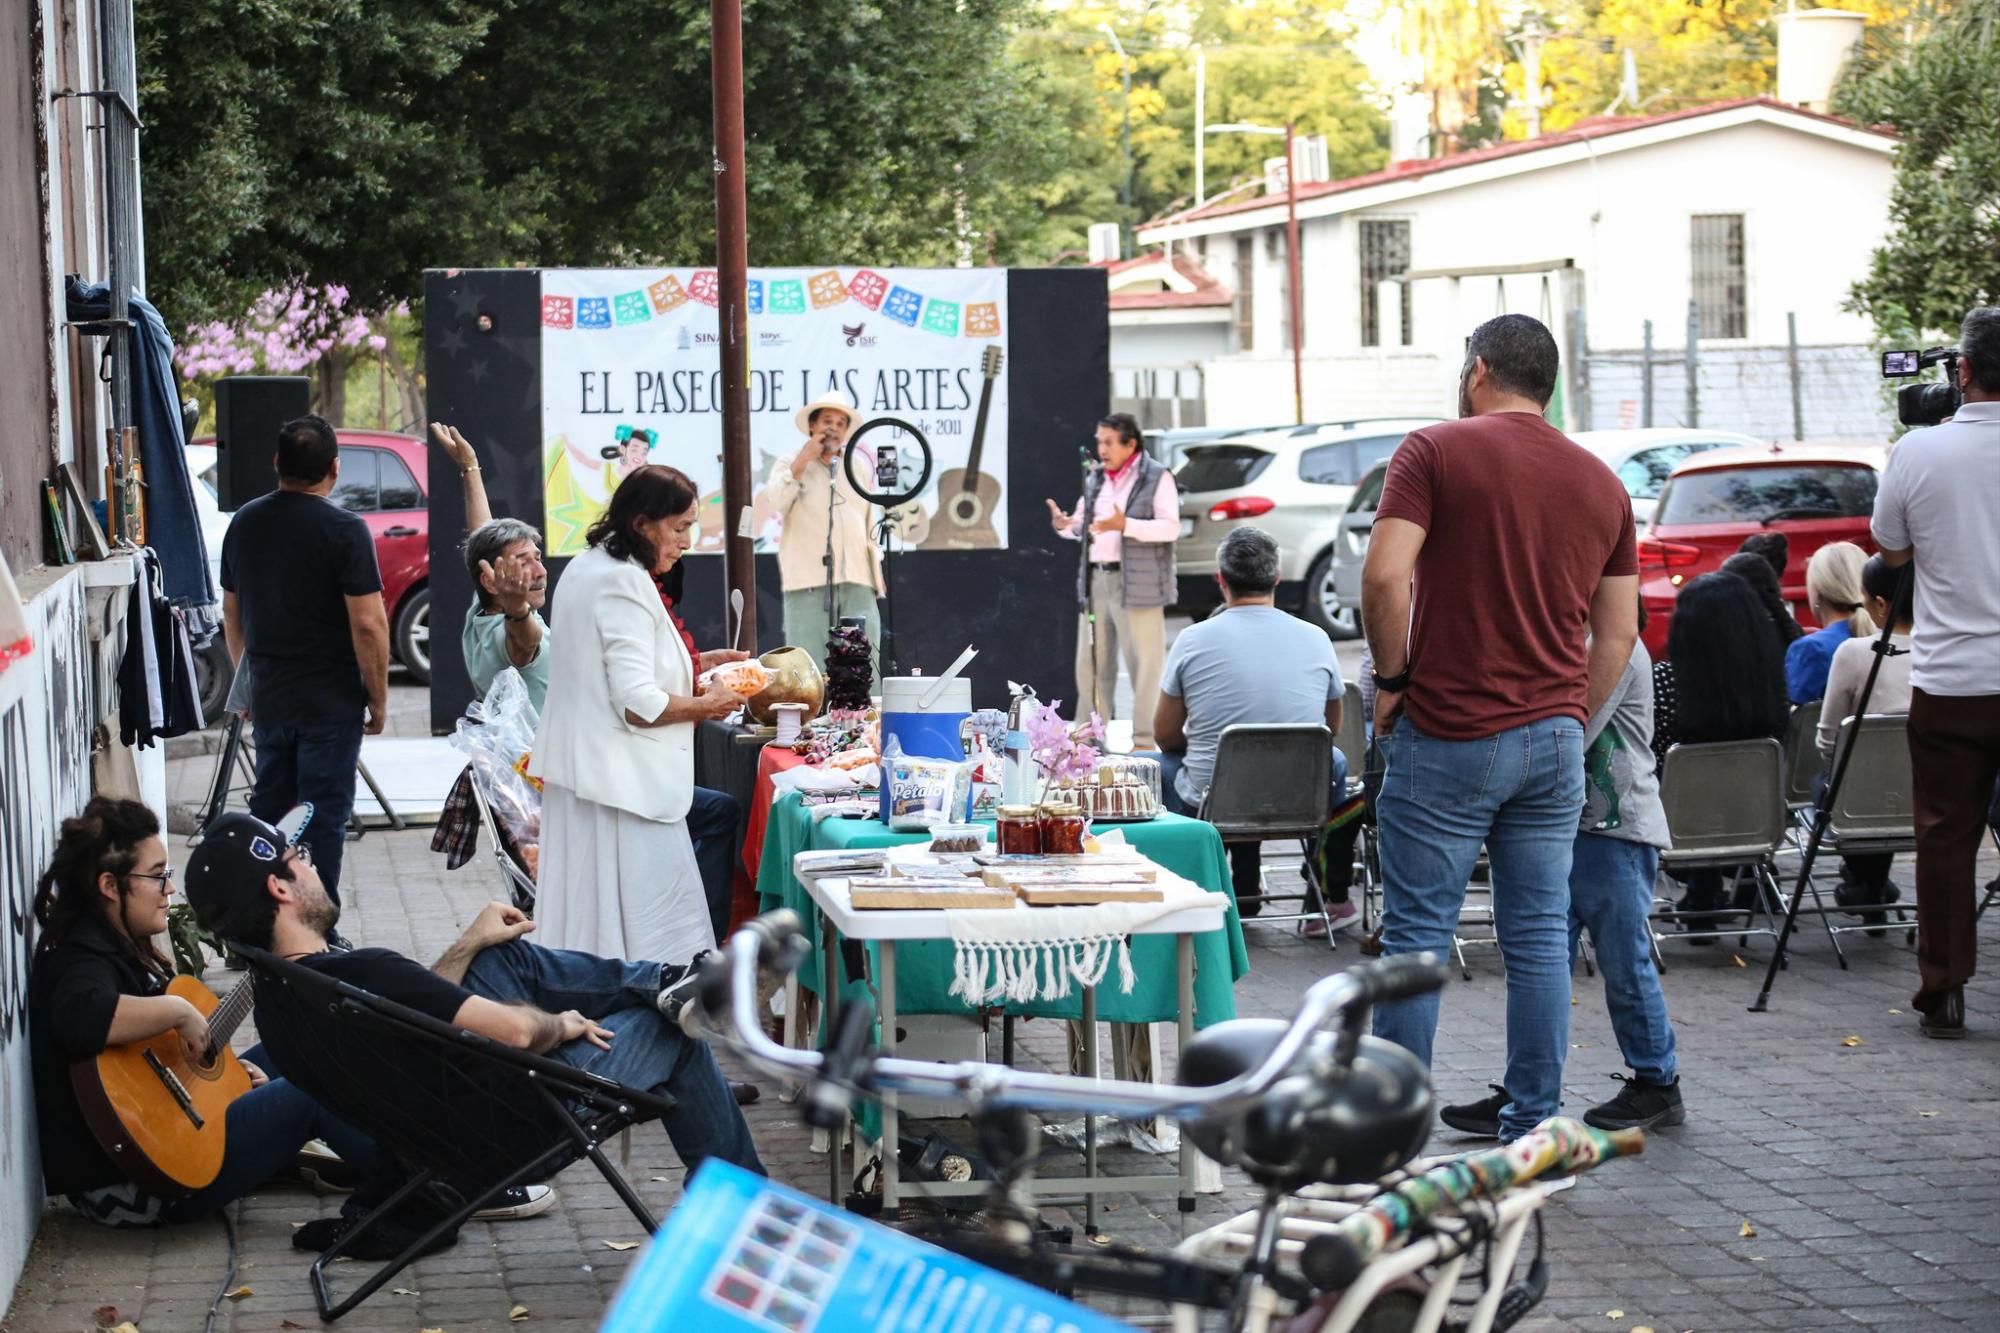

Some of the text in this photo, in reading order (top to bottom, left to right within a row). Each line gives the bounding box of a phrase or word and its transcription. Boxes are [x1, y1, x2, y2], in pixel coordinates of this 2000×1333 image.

[580, 371, 624, 414] EL
[748, 369, 790, 412] DE
[872, 368, 971, 412] ARTES
[936, 418, 962, 435] 2011
